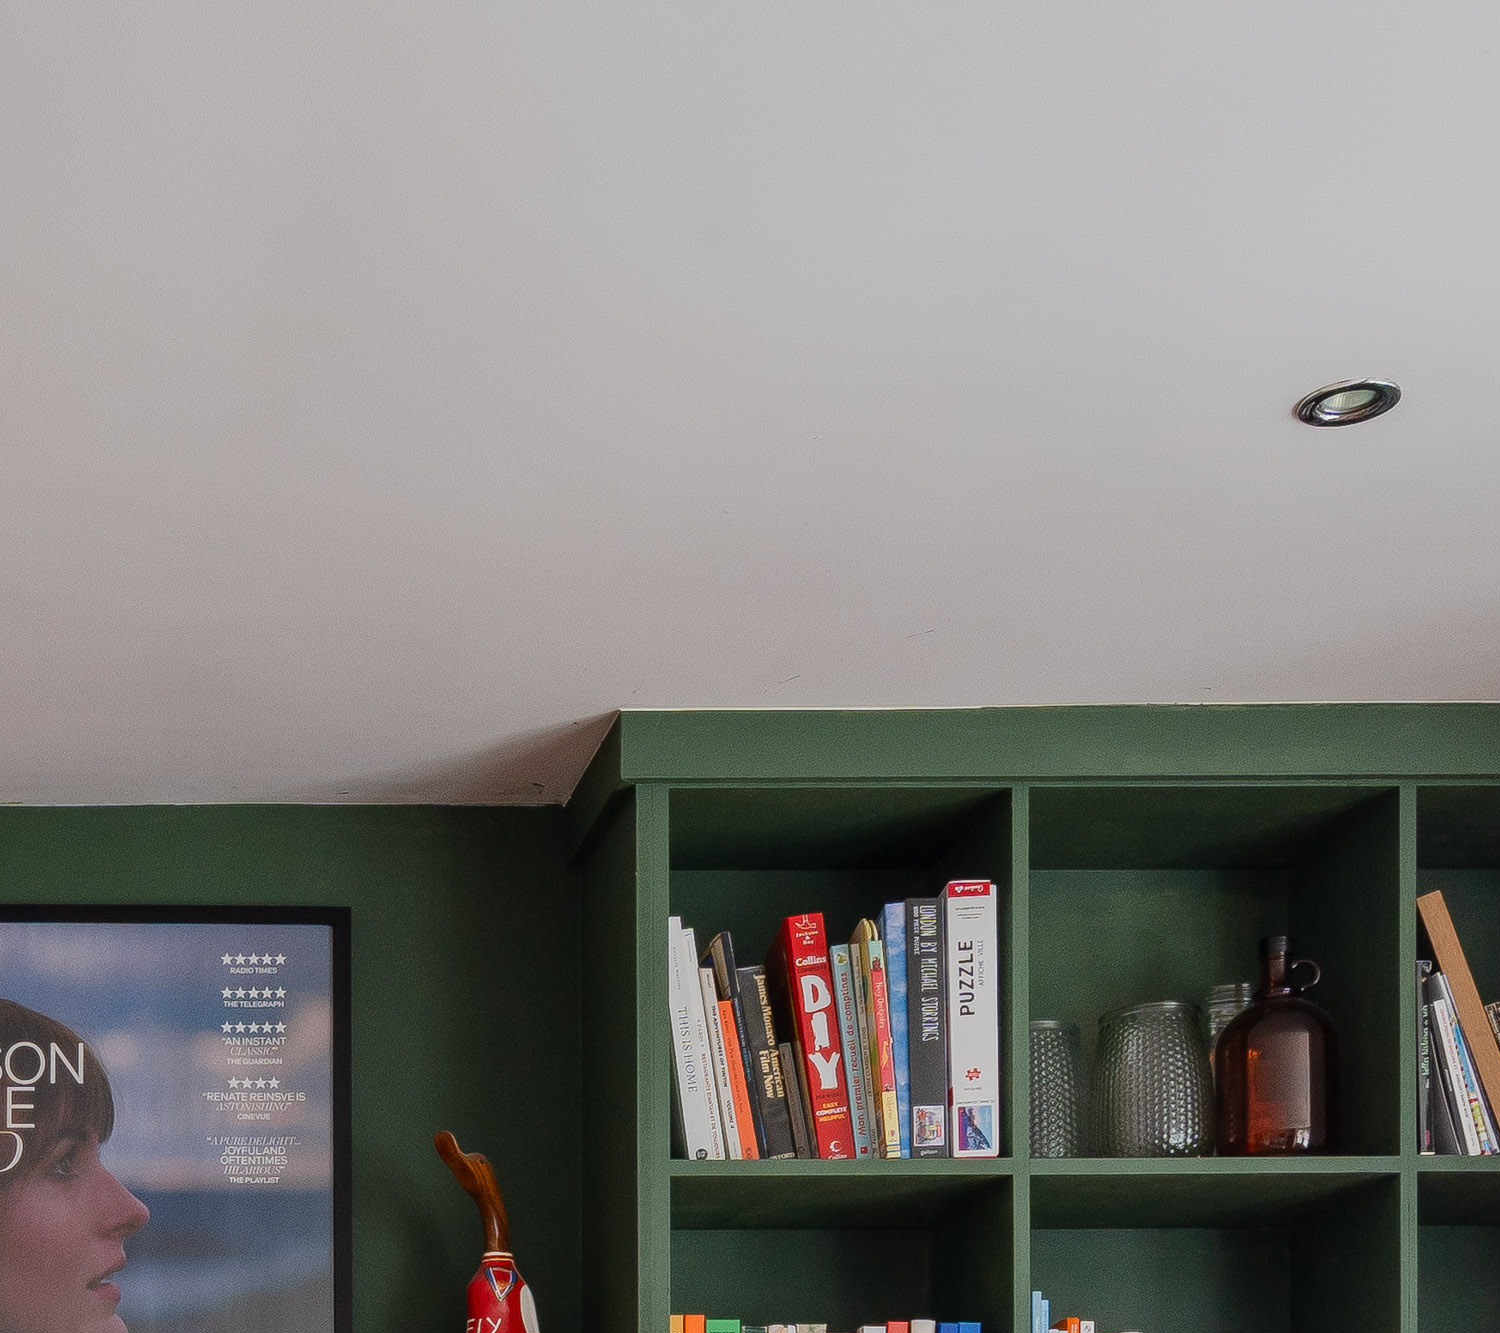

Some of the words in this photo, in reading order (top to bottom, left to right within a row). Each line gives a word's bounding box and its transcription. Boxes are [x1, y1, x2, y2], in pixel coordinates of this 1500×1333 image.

[920, 904, 937, 935] LONDON
[923, 940, 937, 956] BY
[977, 939, 985, 958] VILLE
[795, 955, 828, 967] Collins
[920, 957, 938, 992] MICHAEL
[958, 939, 976, 1017] PUZZLE
[977, 963, 985, 987] AFFICHE
[678, 1007, 691, 1038] THIS
[800, 974, 841, 1090] DIY
[753, 974, 767, 1011] James
[761, 1011, 776, 1048] Monaco
[770, 1048, 786, 1097] American
[759, 1050, 770, 1074] Film
[682, 1055, 698, 1094] HOME
[763, 1075, 775, 1099] Now
[220, 1156, 288, 1165] OFTENTIMES
[223, 1146, 259, 1155] JOYFUL
[260, 1146, 286, 1155] AND
